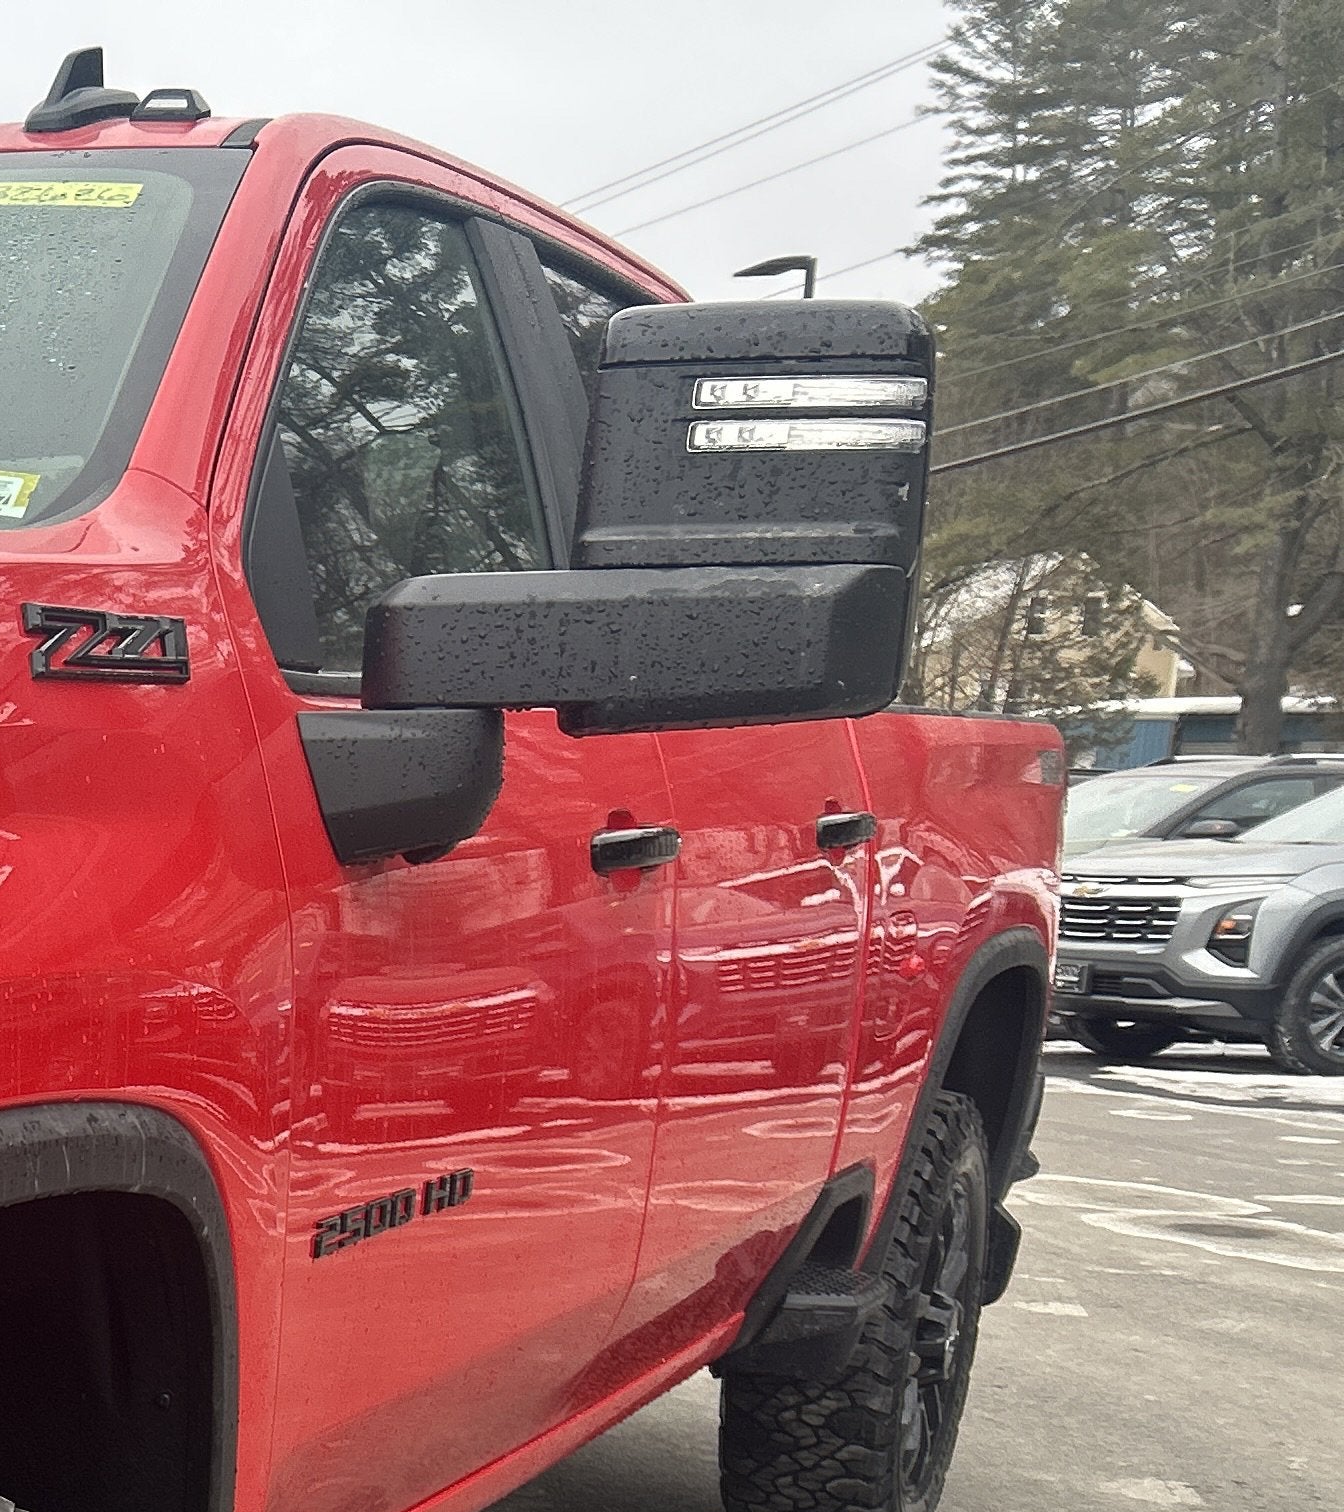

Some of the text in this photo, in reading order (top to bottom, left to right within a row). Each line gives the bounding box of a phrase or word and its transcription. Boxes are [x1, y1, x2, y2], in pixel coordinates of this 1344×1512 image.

[21, 602, 191, 684] Z71
[310, 1167, 475, 1260] 2500 HD
